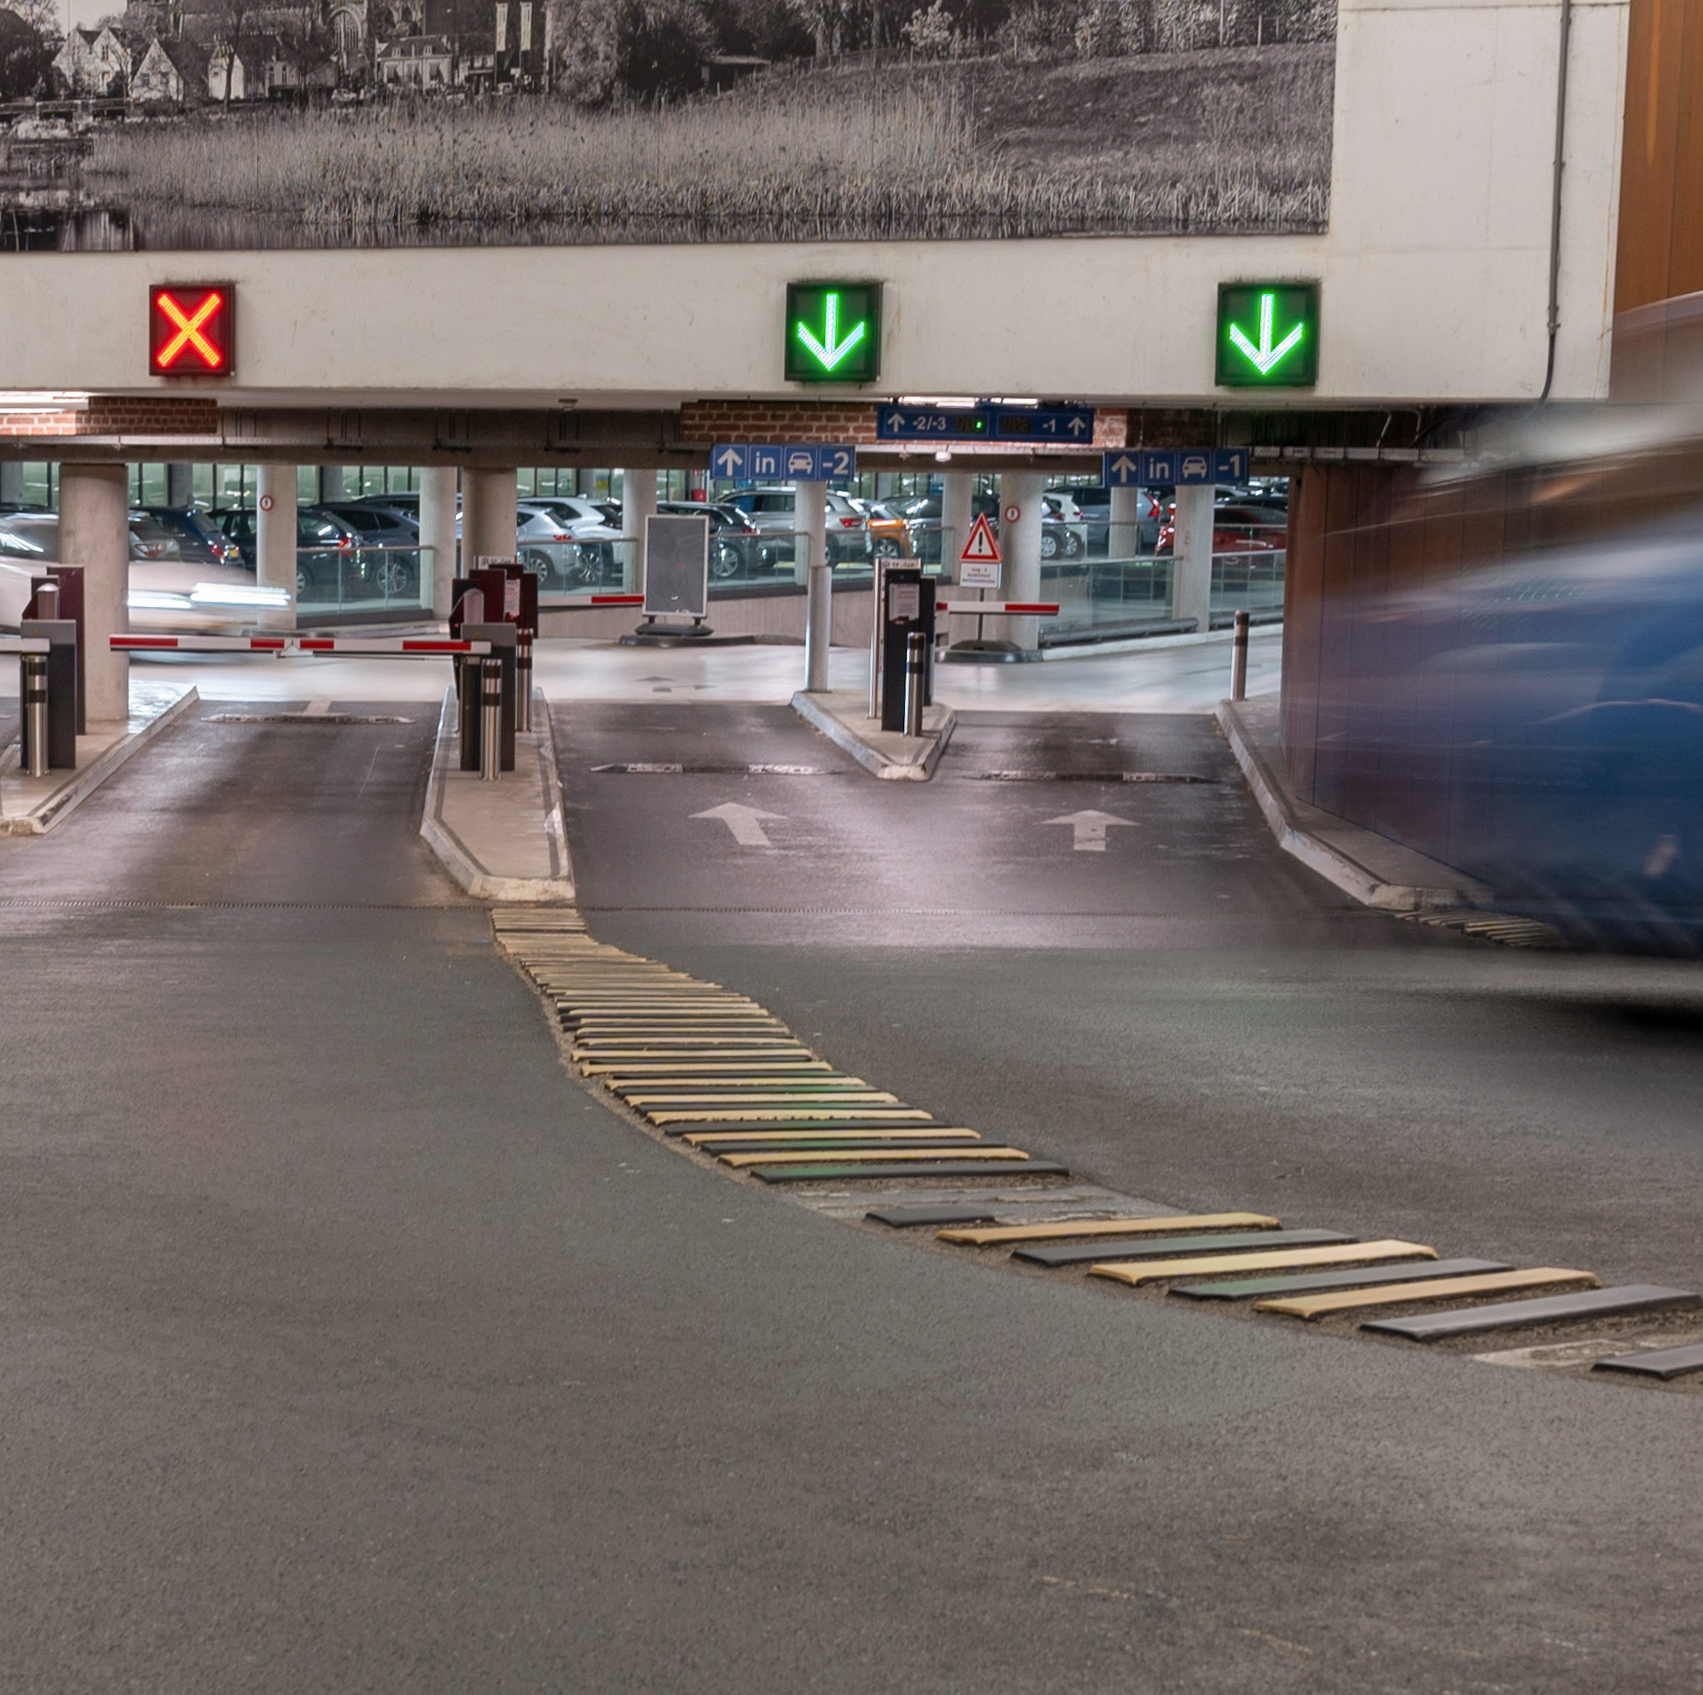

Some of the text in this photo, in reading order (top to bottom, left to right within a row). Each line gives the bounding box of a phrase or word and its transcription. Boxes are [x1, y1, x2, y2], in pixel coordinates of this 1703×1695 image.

[912, 417, 947, 432] -2/-3
[1042, 418, 1058, 433] -1
[755, 452, 850, 475] in -2
[1149, 454, 1241, 479] in -1
